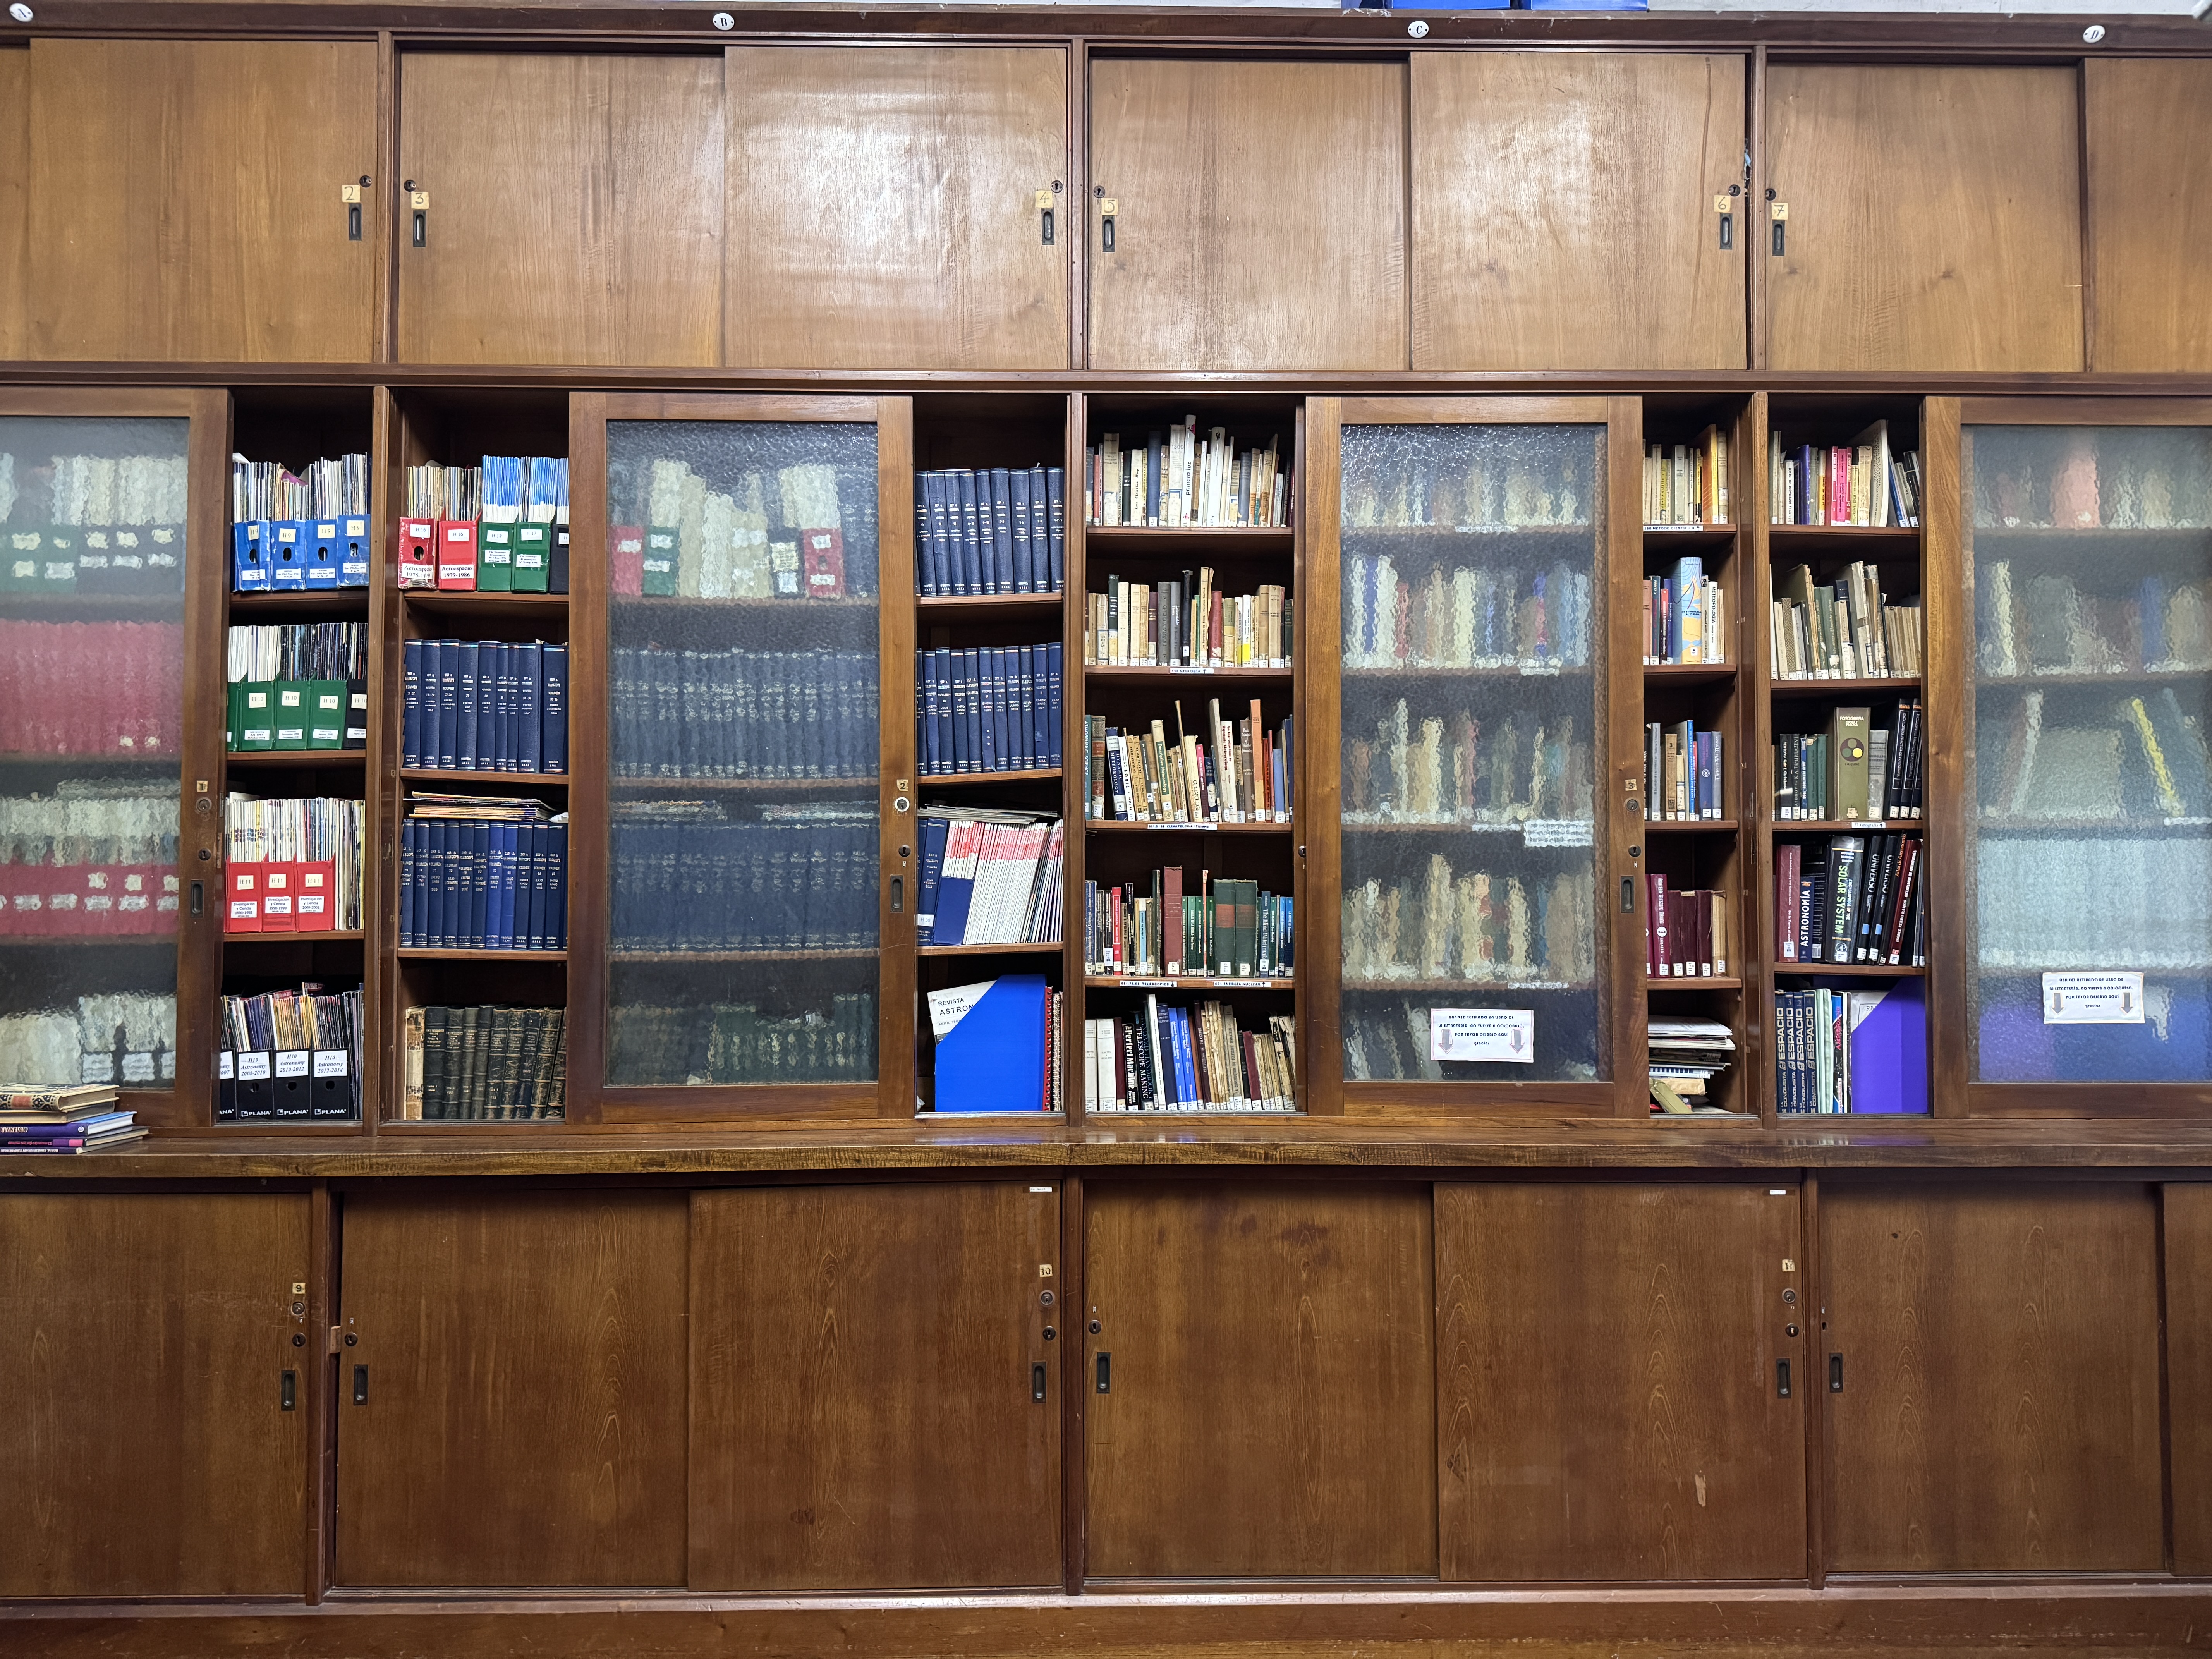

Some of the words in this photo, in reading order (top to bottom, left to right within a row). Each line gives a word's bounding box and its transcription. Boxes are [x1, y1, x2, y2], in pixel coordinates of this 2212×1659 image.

[720, 18, 727, 26] B
[1416, 25, 1422, 34] C
[2090, 30, 2099, 39] D
[345, 187, 354, 201] 2
[415, 193, 424, 204] 3
[1040, 192, 1049, 203] 4
[1104, 200, 1115, 213] 5
[1718, 197, 1726, 210] 6
[1774, 205, 1784, 216] 7
[1110, 752, 1118, 793] METEOROLOGY
[1837, 865, 1848, 894] SOLAR
[1868, 854, 1880, 892] UNIVERSO
[1882, 855, 1894, 893] UNIVERSO
[1800, 890, 1810, 947] ASTRONOMÍA
[1834, 896, 1846, 933] SYSTEM
[938, 998, 964, 1006] REVISTA
[1137, 1027, 1145, 1067] TELESCOPE
[1777, 1008, 1785, 1060] ESPACIO
[1786, 1008, 1795, 1060] ESPACIO
[1795, 1008, 1804, 1060] ESPACIO
[1806, 1007, 1815, 1059] ESPACIO
[1127, 1058, 1135, 1089] Machine
